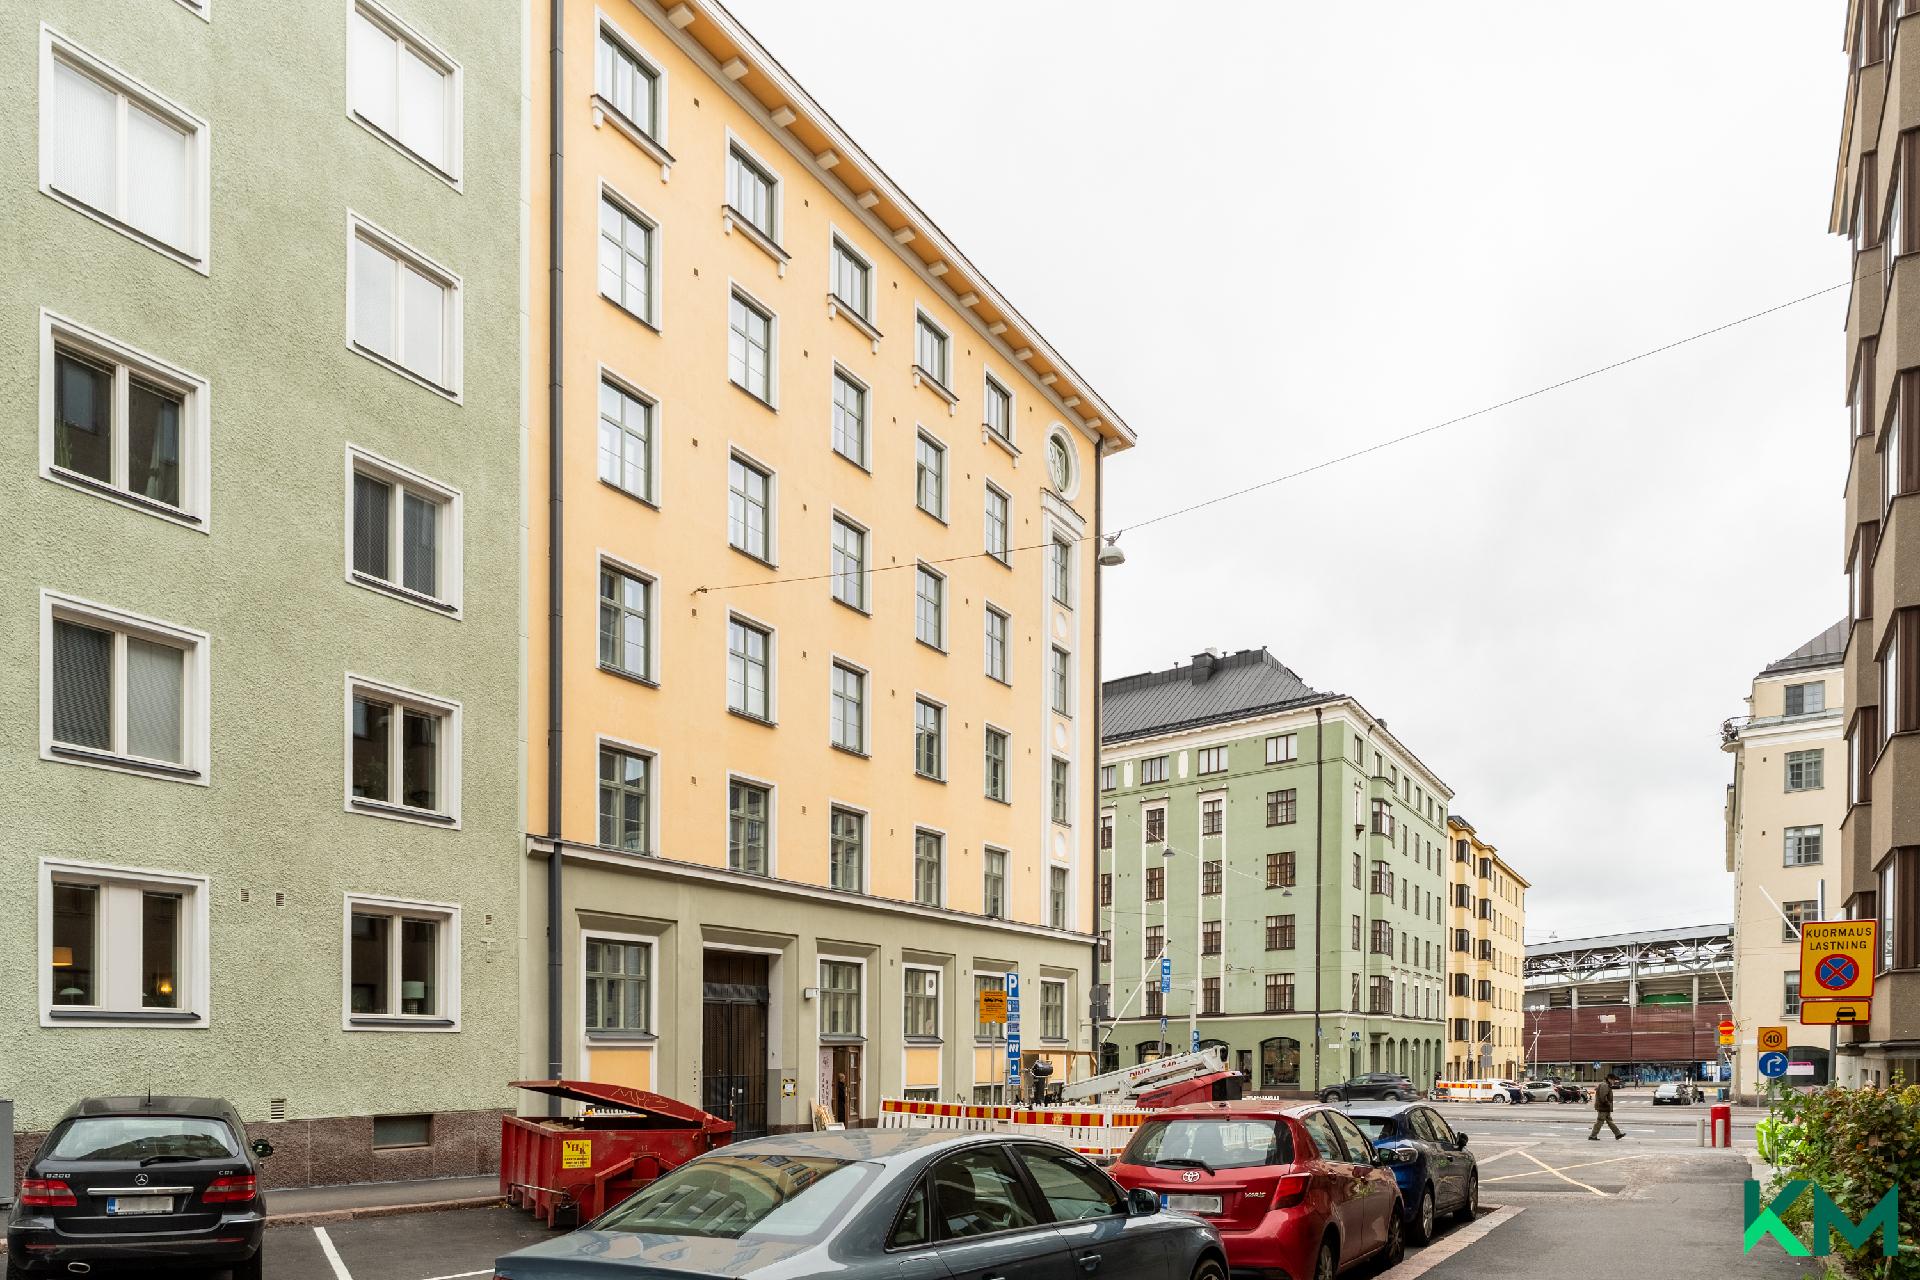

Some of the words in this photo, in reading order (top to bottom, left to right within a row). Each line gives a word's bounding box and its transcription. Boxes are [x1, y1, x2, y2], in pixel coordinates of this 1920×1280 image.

[1805, 927, 1872, 938] KUORMAUS
[1810, 940, 1867, 951] LASTNING
[1008, 974, 1017, 997] P
[1765, 1034, 1780, 1044] 40
